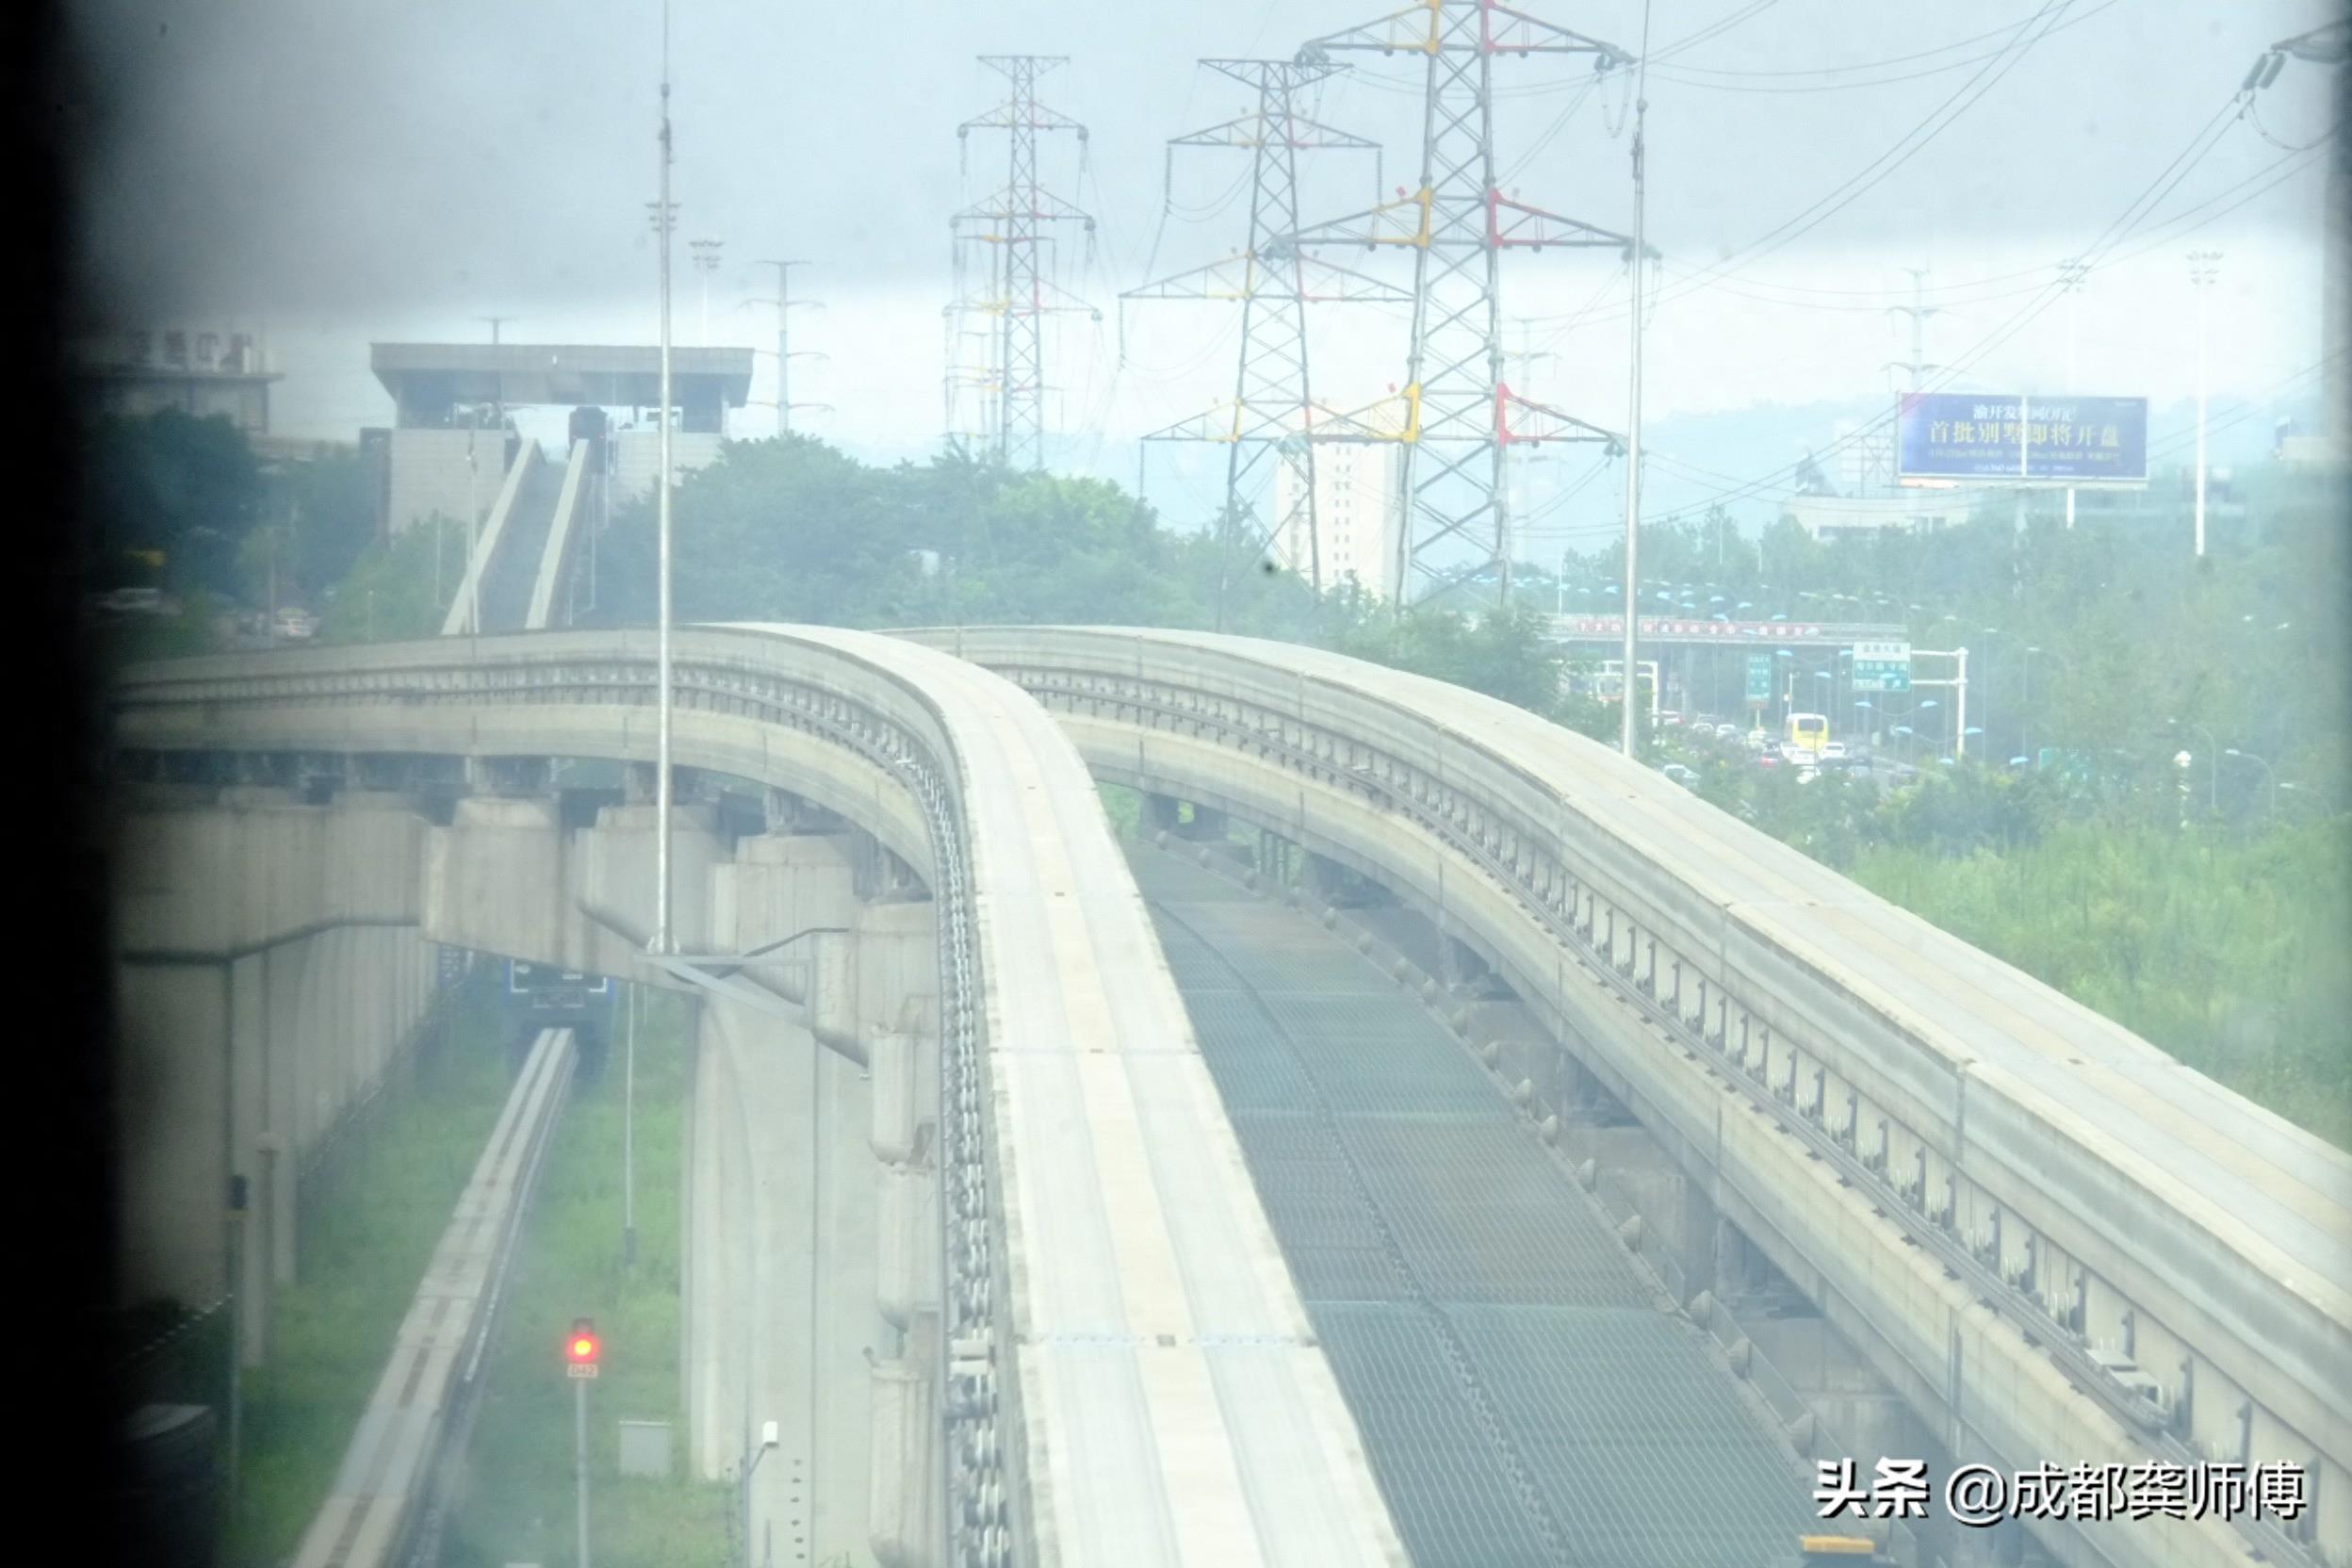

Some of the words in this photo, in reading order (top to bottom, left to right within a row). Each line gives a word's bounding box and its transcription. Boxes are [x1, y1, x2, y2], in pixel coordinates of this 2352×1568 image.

[1930, 421, 2120, 447] 首批别墅即将开盘
